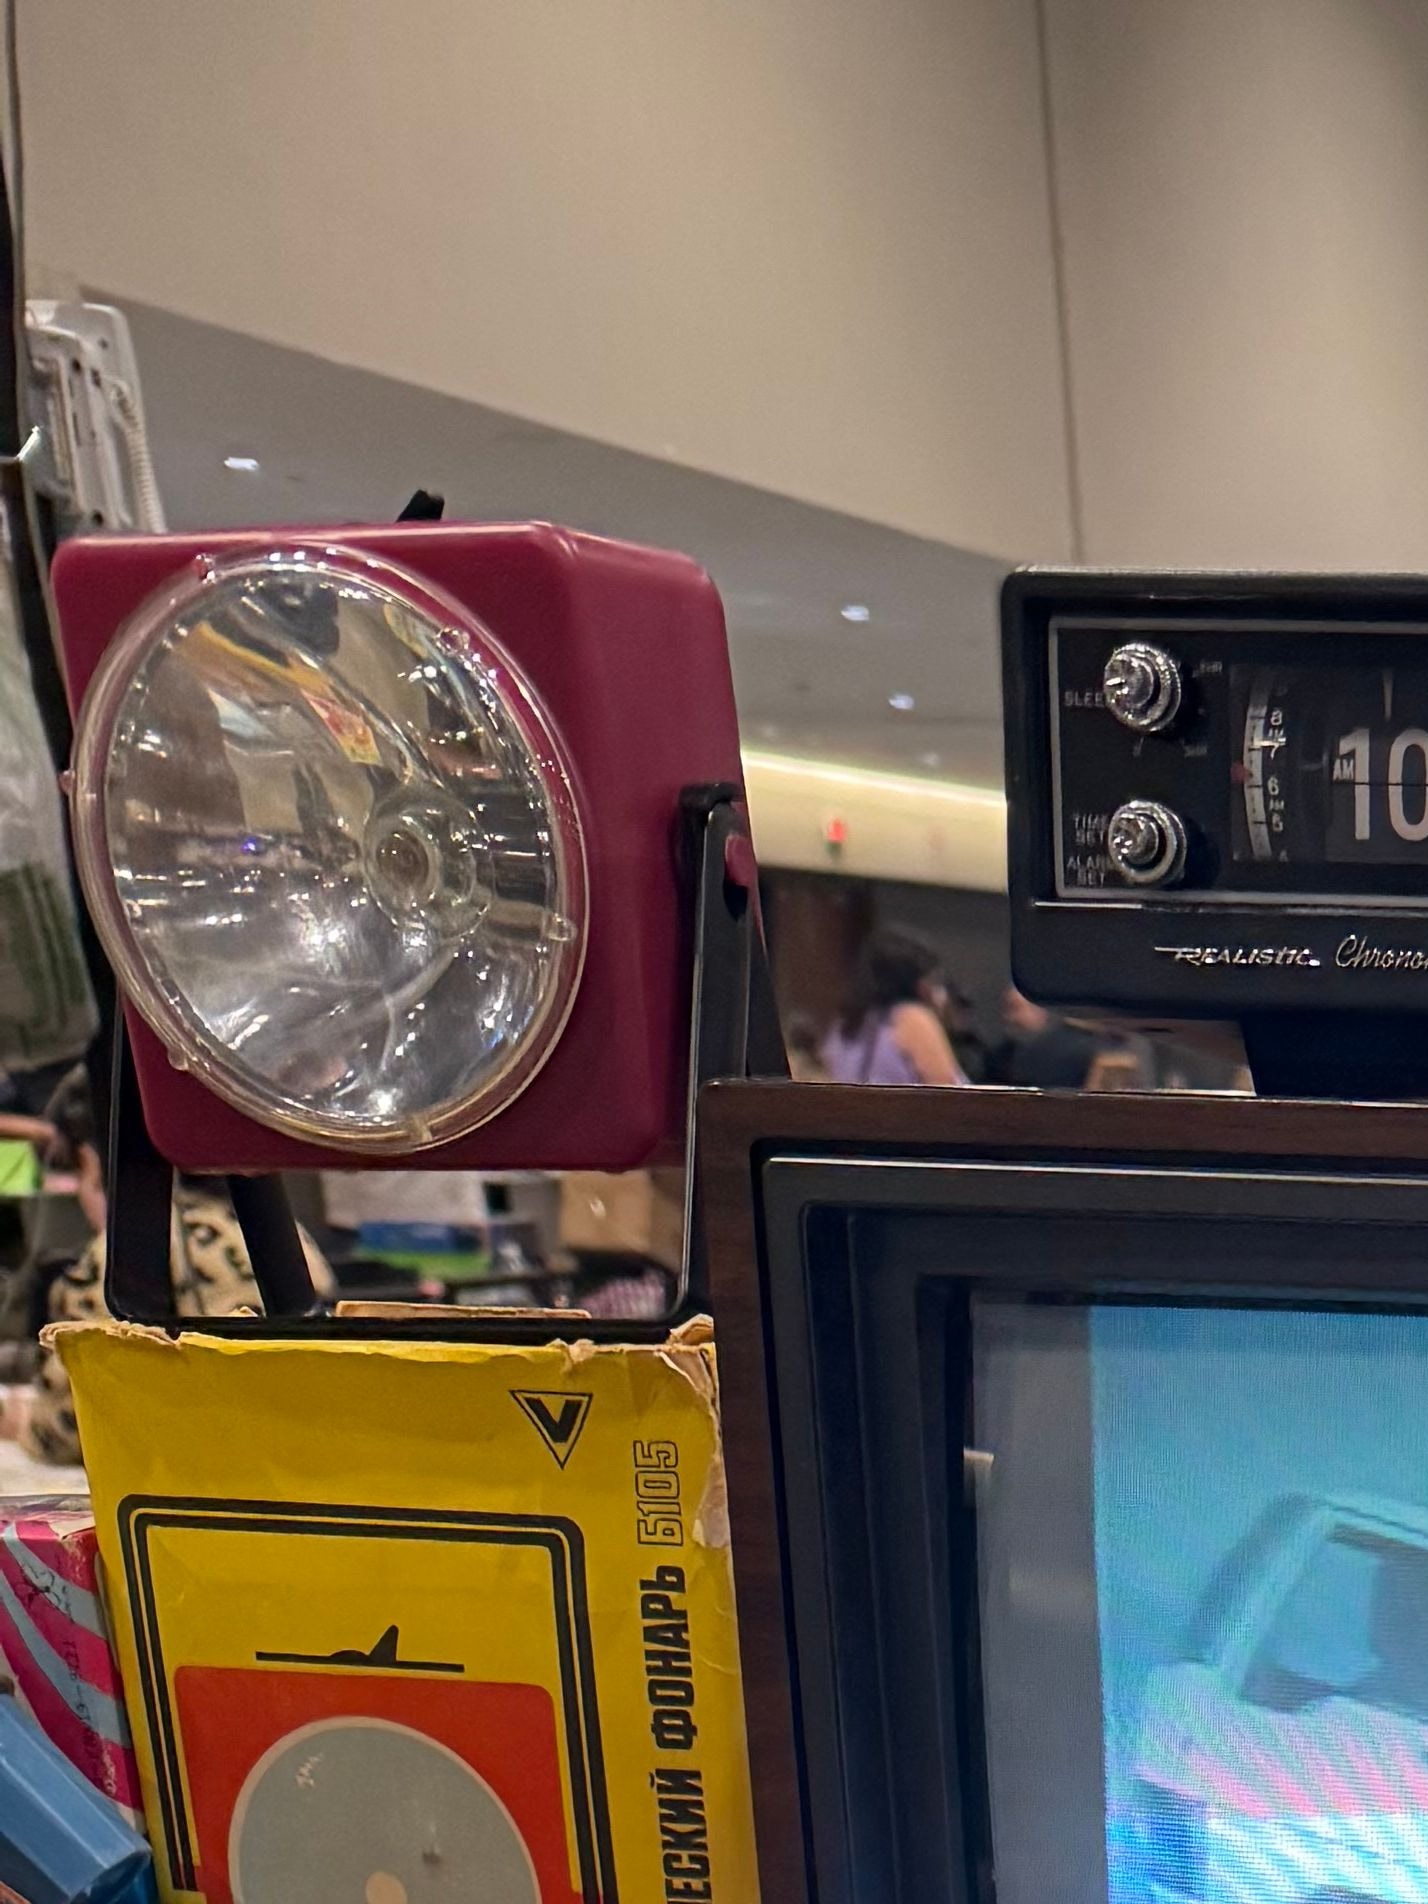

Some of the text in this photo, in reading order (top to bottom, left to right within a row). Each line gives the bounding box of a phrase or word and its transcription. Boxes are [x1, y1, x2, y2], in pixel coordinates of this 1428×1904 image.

[1156, 946, 1317, 969] REALISTIC
[632, 1439, 685, 1548] Б105
[638, 1564, 698, 1752] ФОНАРЬ
